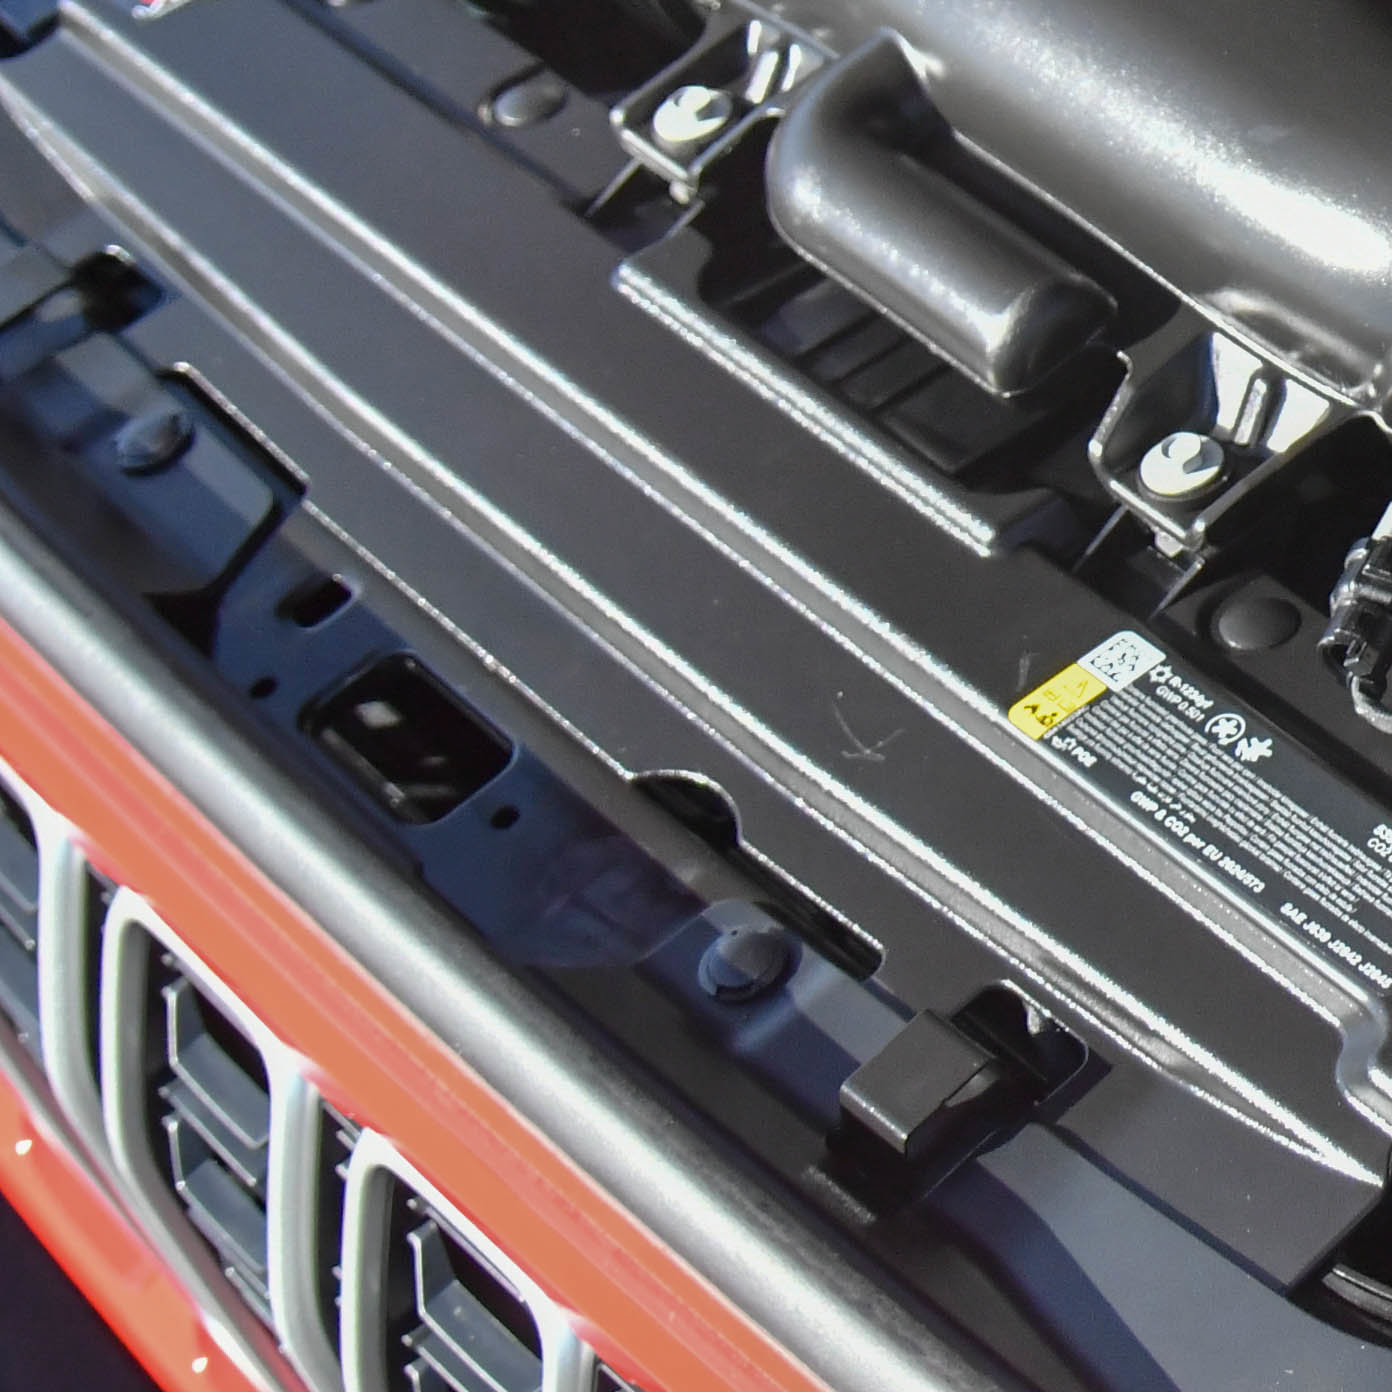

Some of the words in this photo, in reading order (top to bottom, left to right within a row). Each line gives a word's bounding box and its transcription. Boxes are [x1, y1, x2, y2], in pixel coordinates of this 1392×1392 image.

[1152, 684, 1183, 706] GWP
[1069, 745, 1099, 768] POE
[1127, 789, 1160, 815] GWP
[1152, 807, 1169, 821] &
[1161, 813, 1191, 838] CO2
[1181, 831, 1207, 852] per
[1200, 843, 1224, 862] EU
[1364, 836, 1392, 858] CO2
[1277, 900, 1309, 926] SAE
